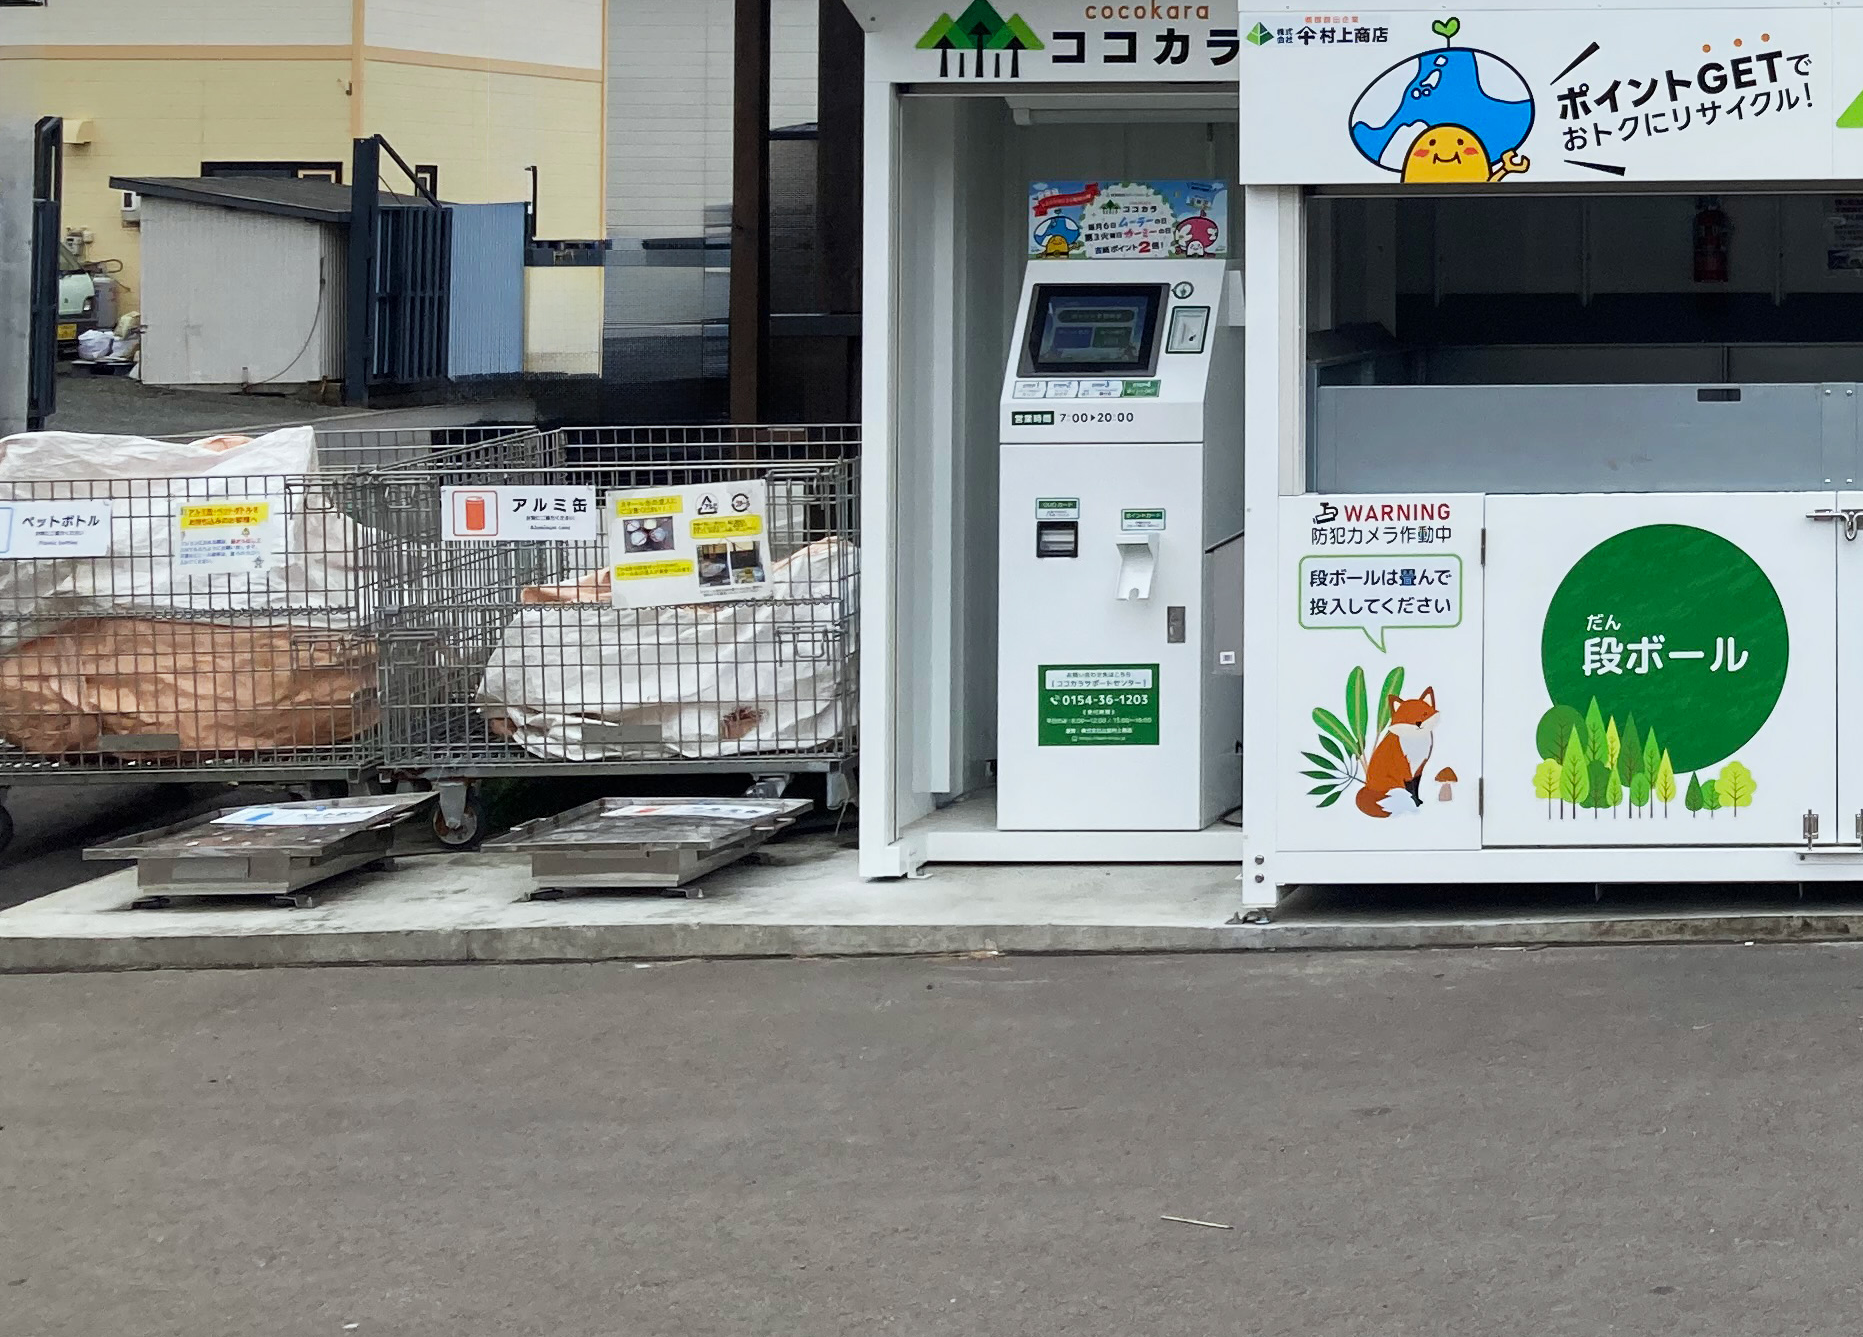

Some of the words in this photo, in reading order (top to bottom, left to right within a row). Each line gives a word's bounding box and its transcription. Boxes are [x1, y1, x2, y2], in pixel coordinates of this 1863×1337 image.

[1320, 27, 1389, 43] 村上商店
[1052, 28, 1240, 66] ココカラ
[1557, 51, 1813, 120] ポイントGETで
[1562, 92, 1813, 152] おトクにリサイクル!
[512, 497, 587, 513] アルミ缶
[1344, 503, 1451, 522] WARNING
[22, 515, 100, 528] ペットボトル
[1311, 525, 1452, 546] 防犯カメラ作動中
[1309, 568, 1452, 588] 段ボールは畳んで
[1309, 597, 1451, 616] 投入してください
[1586, 613, 1621, 632] だん
[1582, 634, 1749, 677] 段ボール
[1062, 694, 1149, 706] 0154-36-1203
